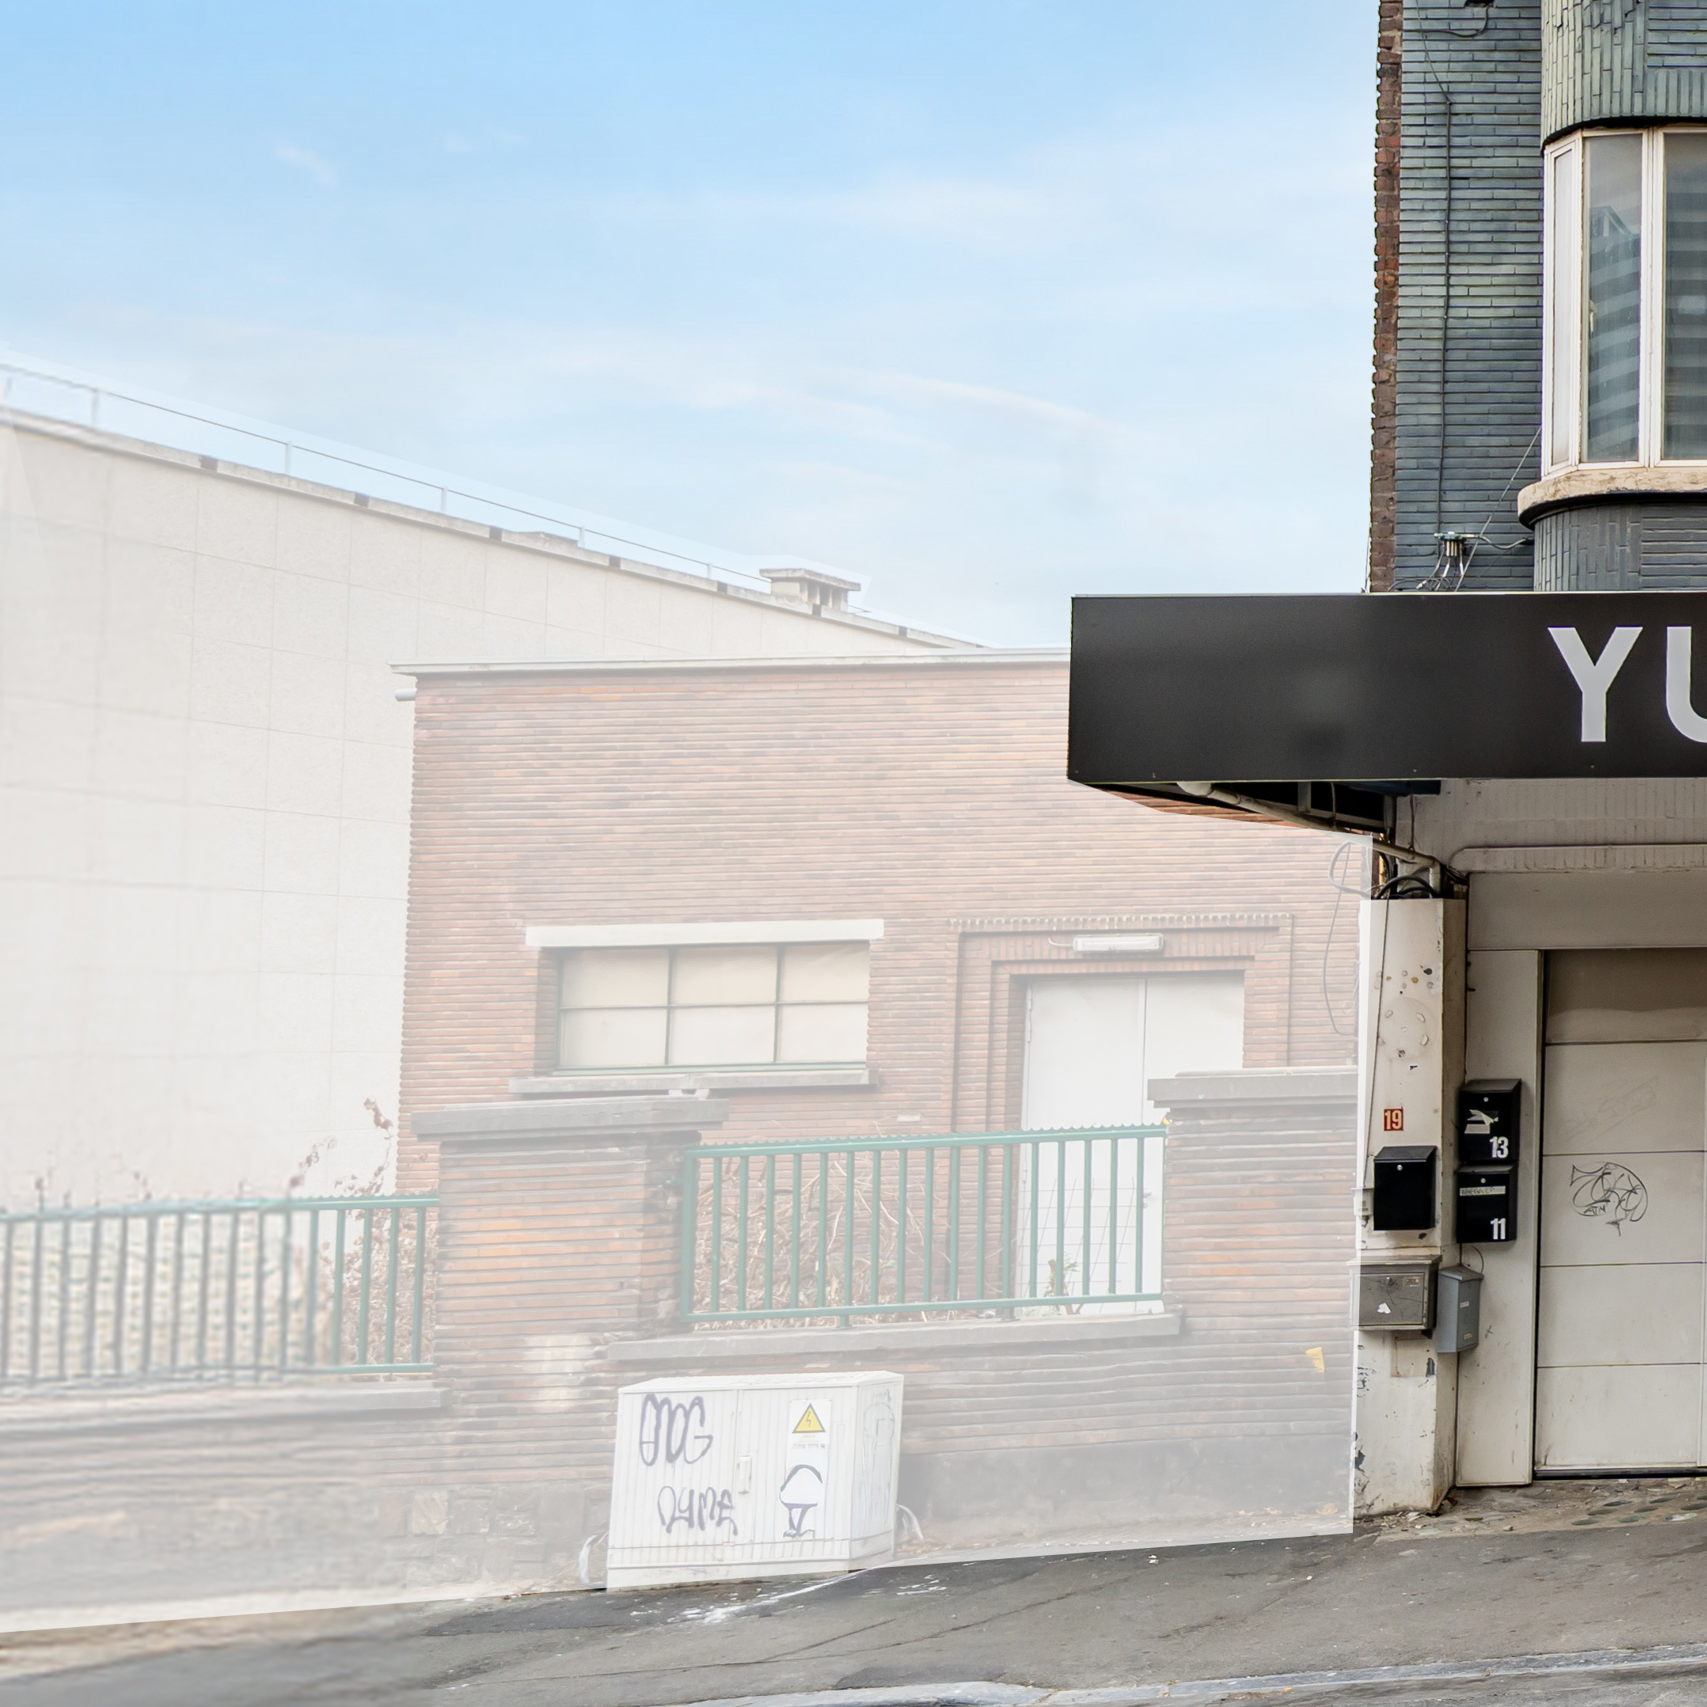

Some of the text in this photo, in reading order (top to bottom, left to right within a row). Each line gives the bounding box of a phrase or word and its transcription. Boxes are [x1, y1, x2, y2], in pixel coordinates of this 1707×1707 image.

[1385, 1110, 1402, 1130] 19
[1489, 1136, 1509, 1158] 13
[1490, 1218, 1506, 1240] 11
